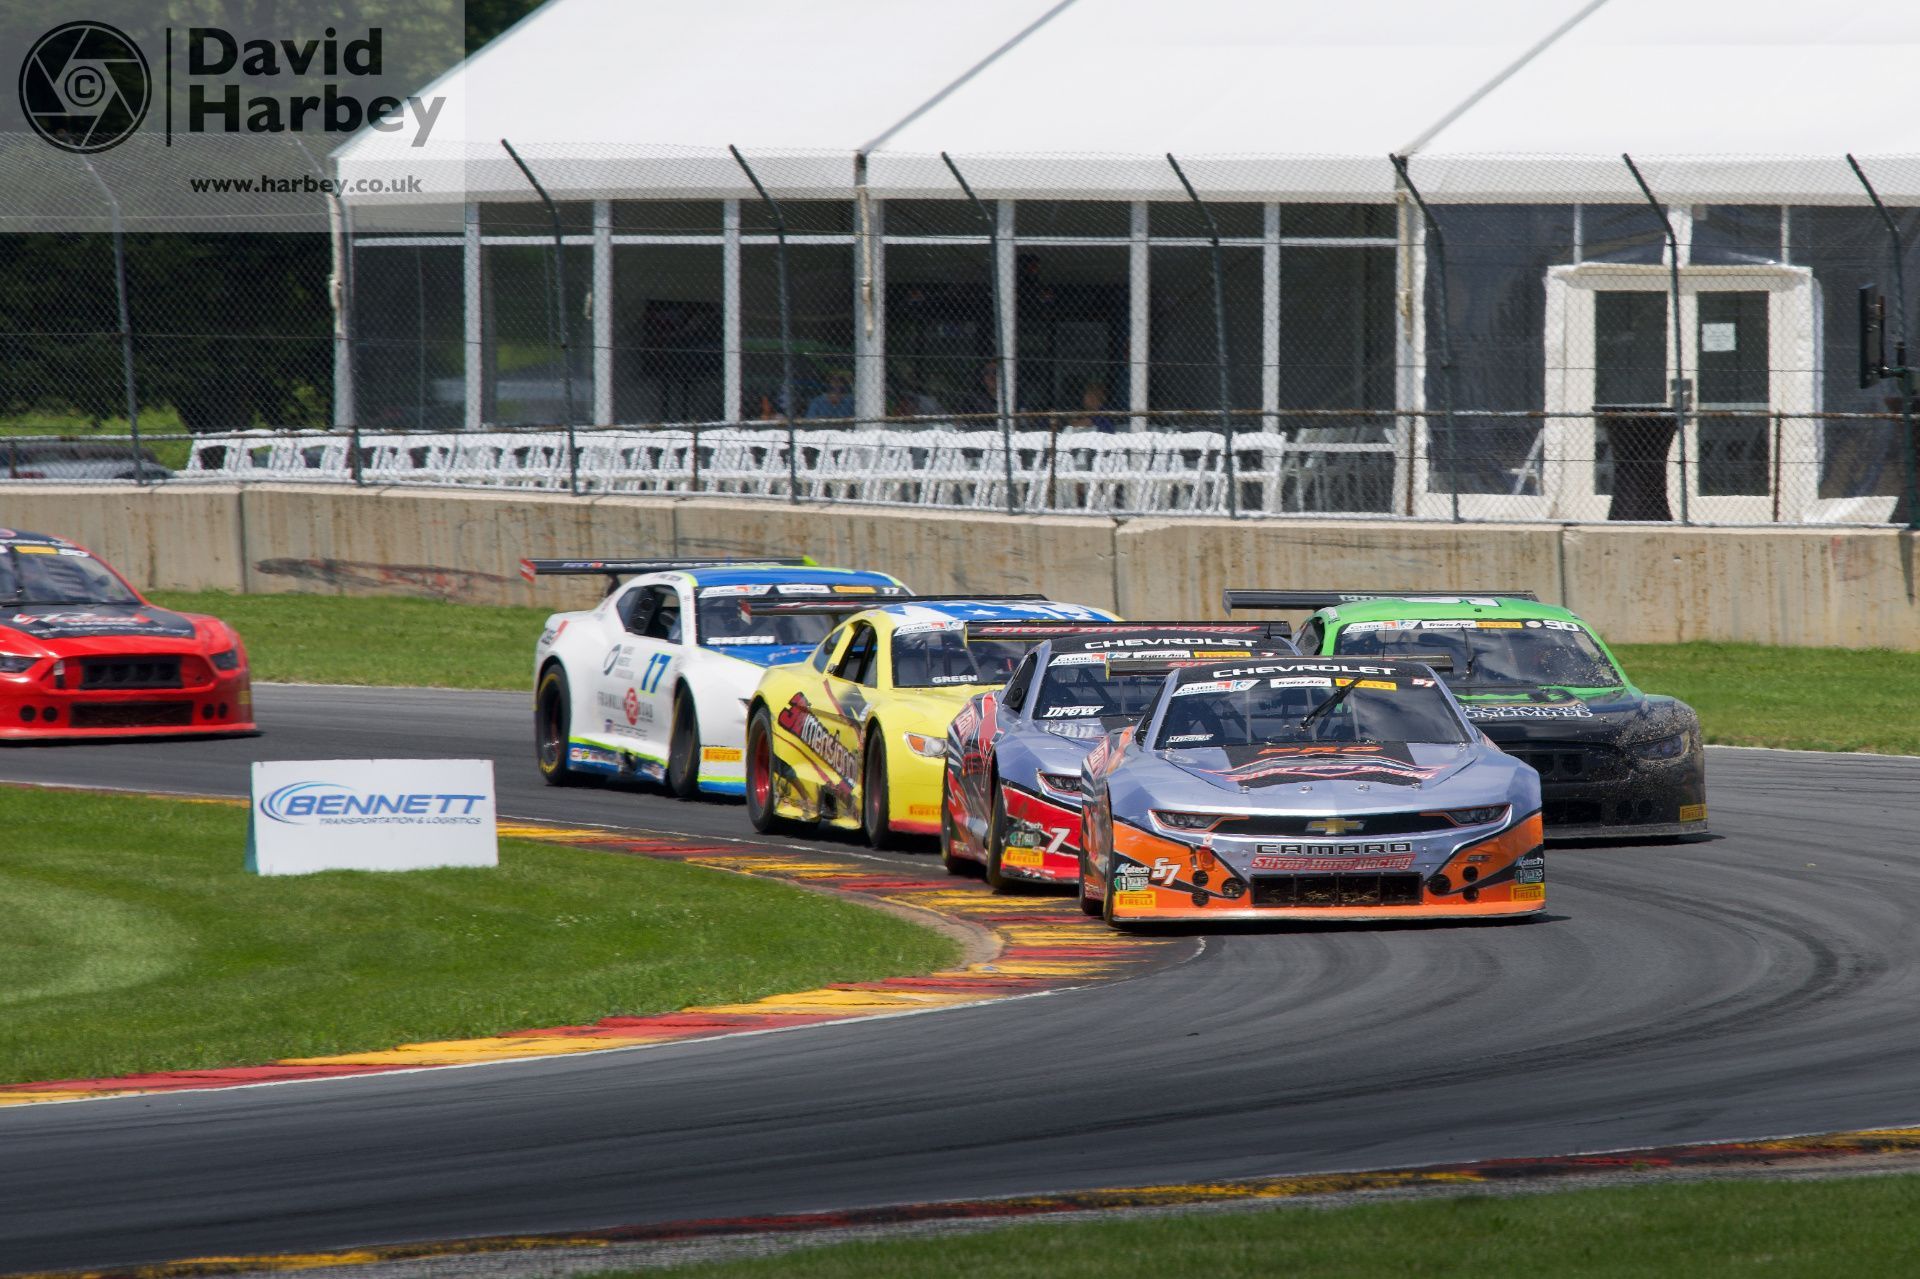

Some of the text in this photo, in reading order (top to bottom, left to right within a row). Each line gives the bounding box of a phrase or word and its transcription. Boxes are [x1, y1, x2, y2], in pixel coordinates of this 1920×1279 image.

[1084, 638, 1257, 650] CHEVROLET
[641, 653, 672, 693] 17
[1213, 665, 1396, 678] CHEVROLET
[932, 675, 978, 683] GREEN
[1465, 709, 1593, 720] UNLIMITED
[285, 794, 486, 815] BENNETT
[1046, 828, 1071, 853] 7
[1255, 842, 1413, 855] CAMARO
[1152, 858, 1181, 885] 57
